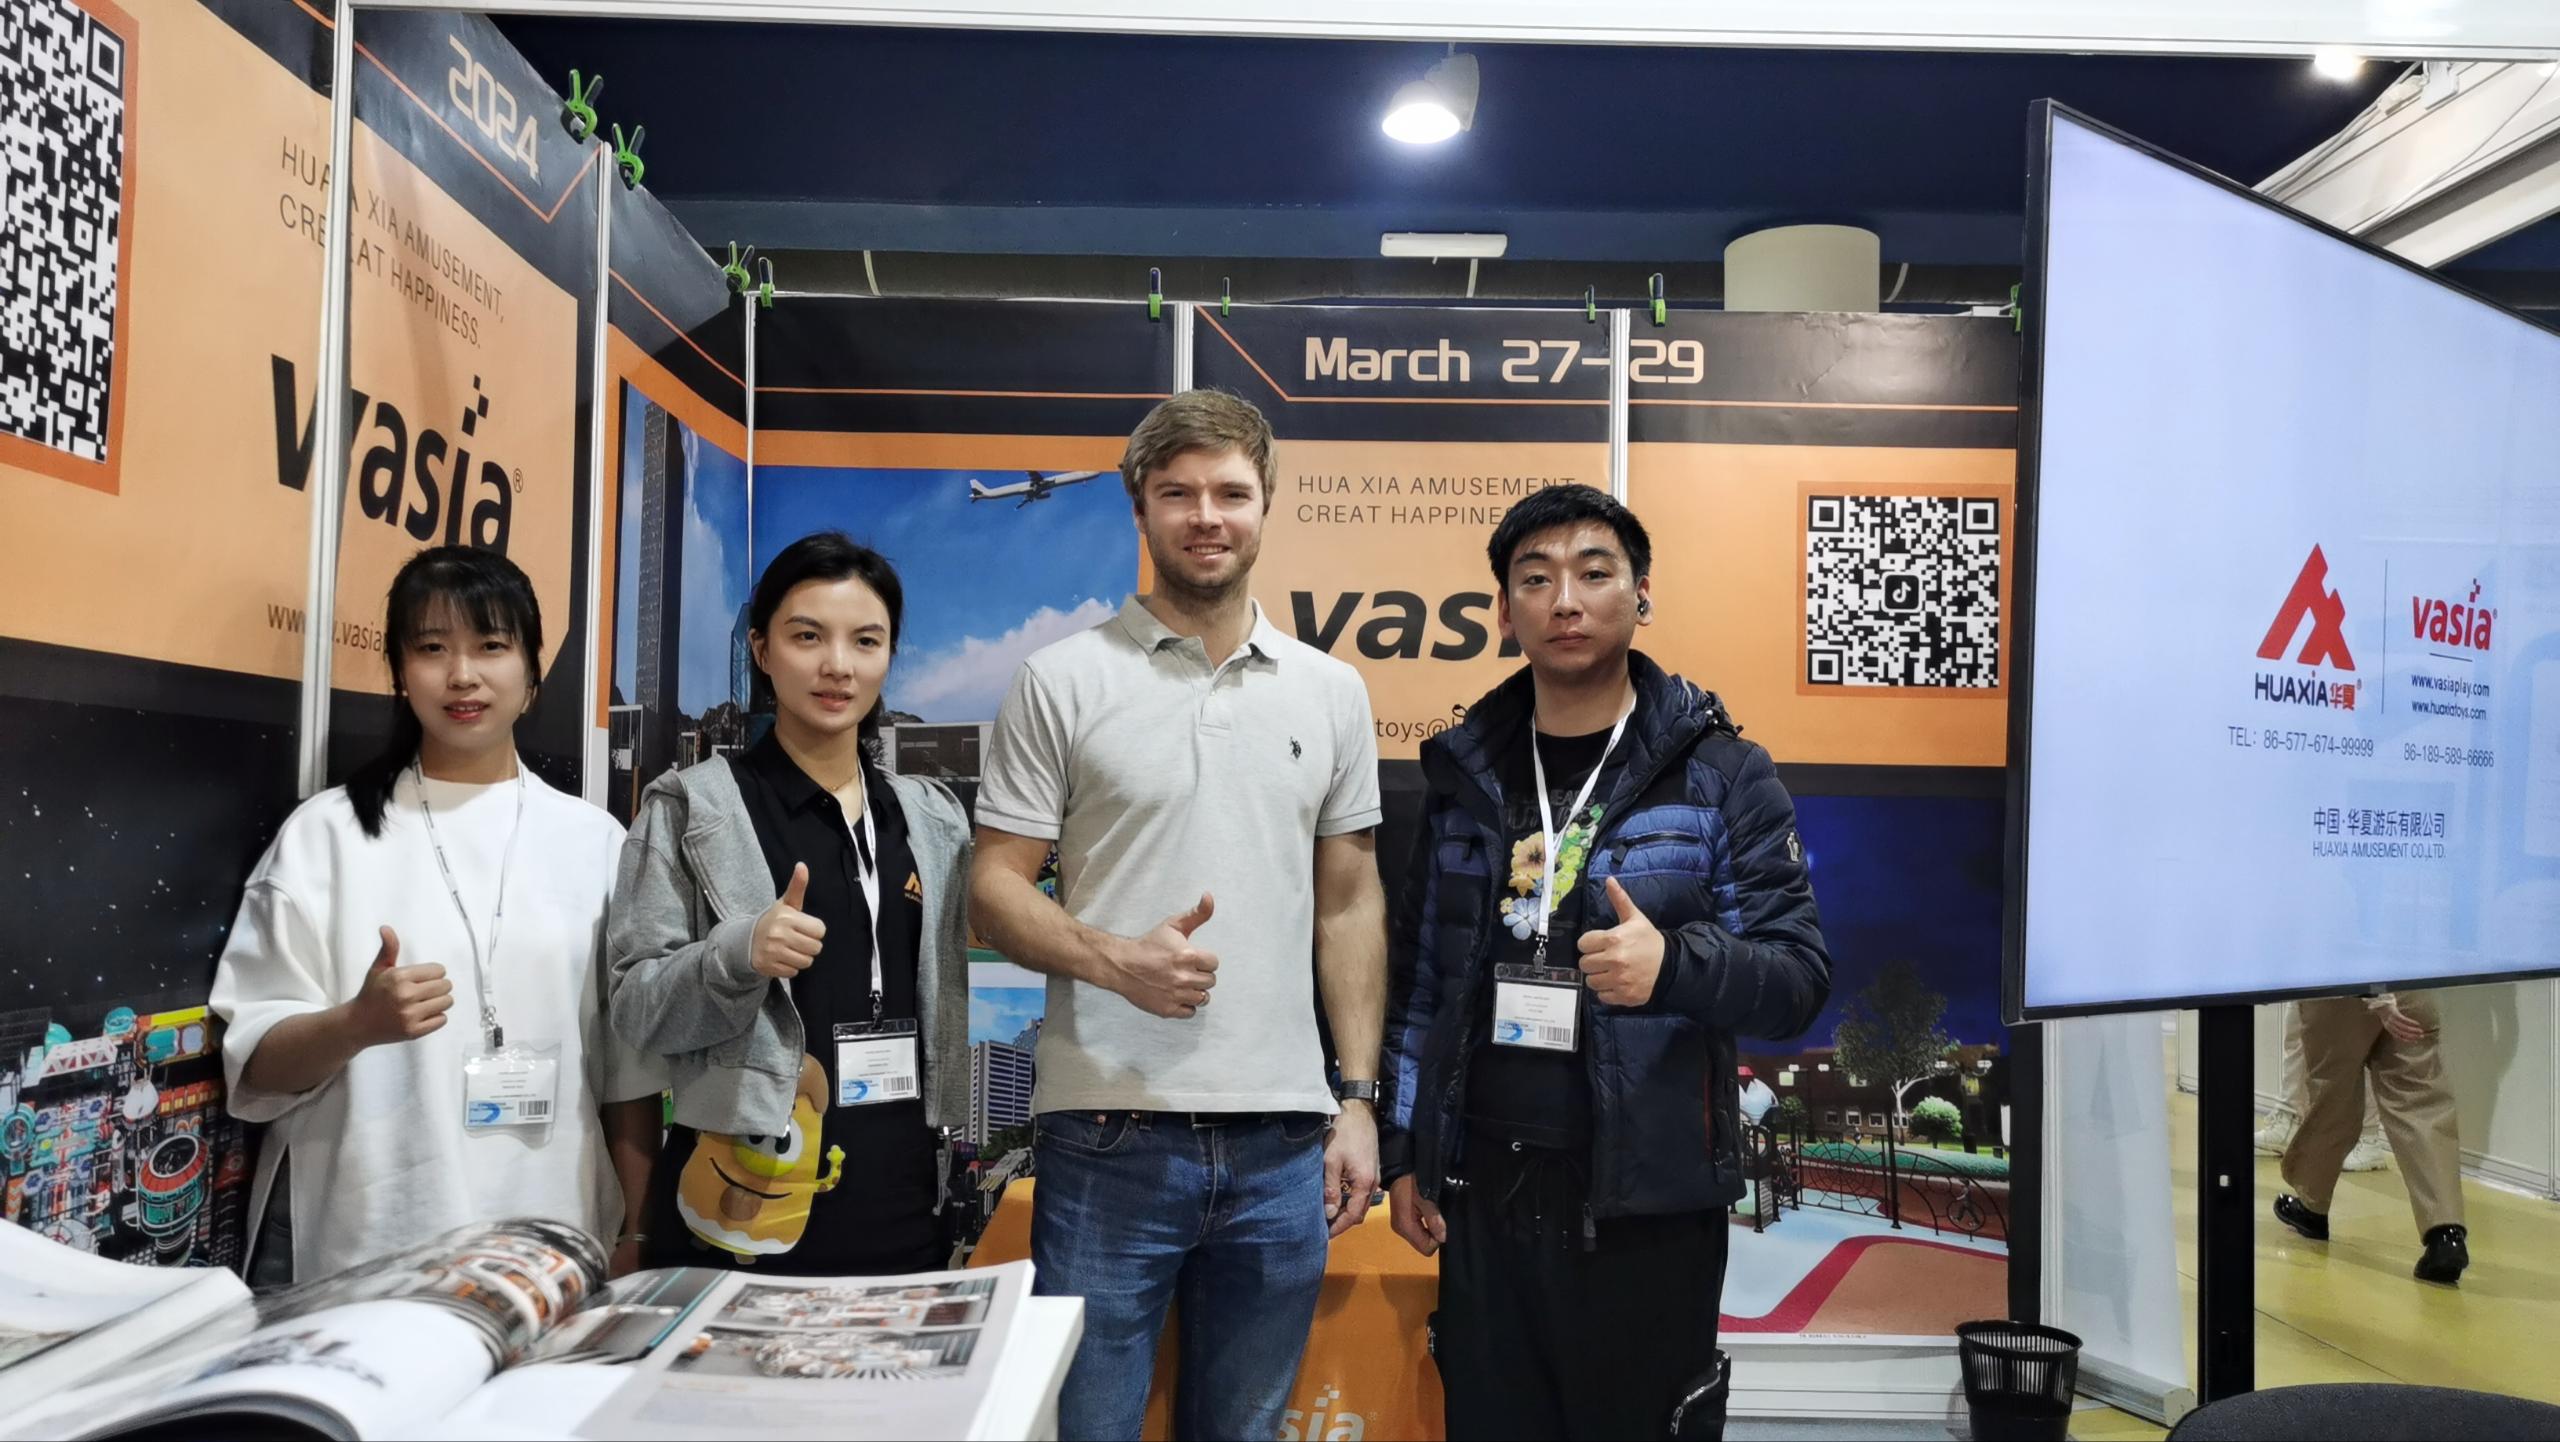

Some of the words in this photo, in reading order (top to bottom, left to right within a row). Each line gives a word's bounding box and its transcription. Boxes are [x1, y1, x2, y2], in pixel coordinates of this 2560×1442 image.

[449, 34, 540, 184] 2024
[367, 190, 399, 240] XIA
[1305, 337, 1470, 382] March
[1299, 475, 1350, 494] HUA
[1360, 476, 1401, 495] XIA
[1297, 504, 1381, 524] CREAT
[1391, 506, 1513, 525] HAPPINE
[1290, 590, 1524, 661] vas
[2413, 578, 2492, 651] vasia
[2411, 674, 2490, 699] www.vasiaplay.com
[2412, 699, 2487, 721] www.huaxiatoys.com
[2228, 726, 2257, 747] TEL:
[2263, 729, 2374, 757] 86-577-674-99999
[2403, 743, 2495, 768] 86-189-589-66666
[2313, 840, 2349, 858] HUAXIA
[2351, 842, 2409, 859] AMUSEMENT
